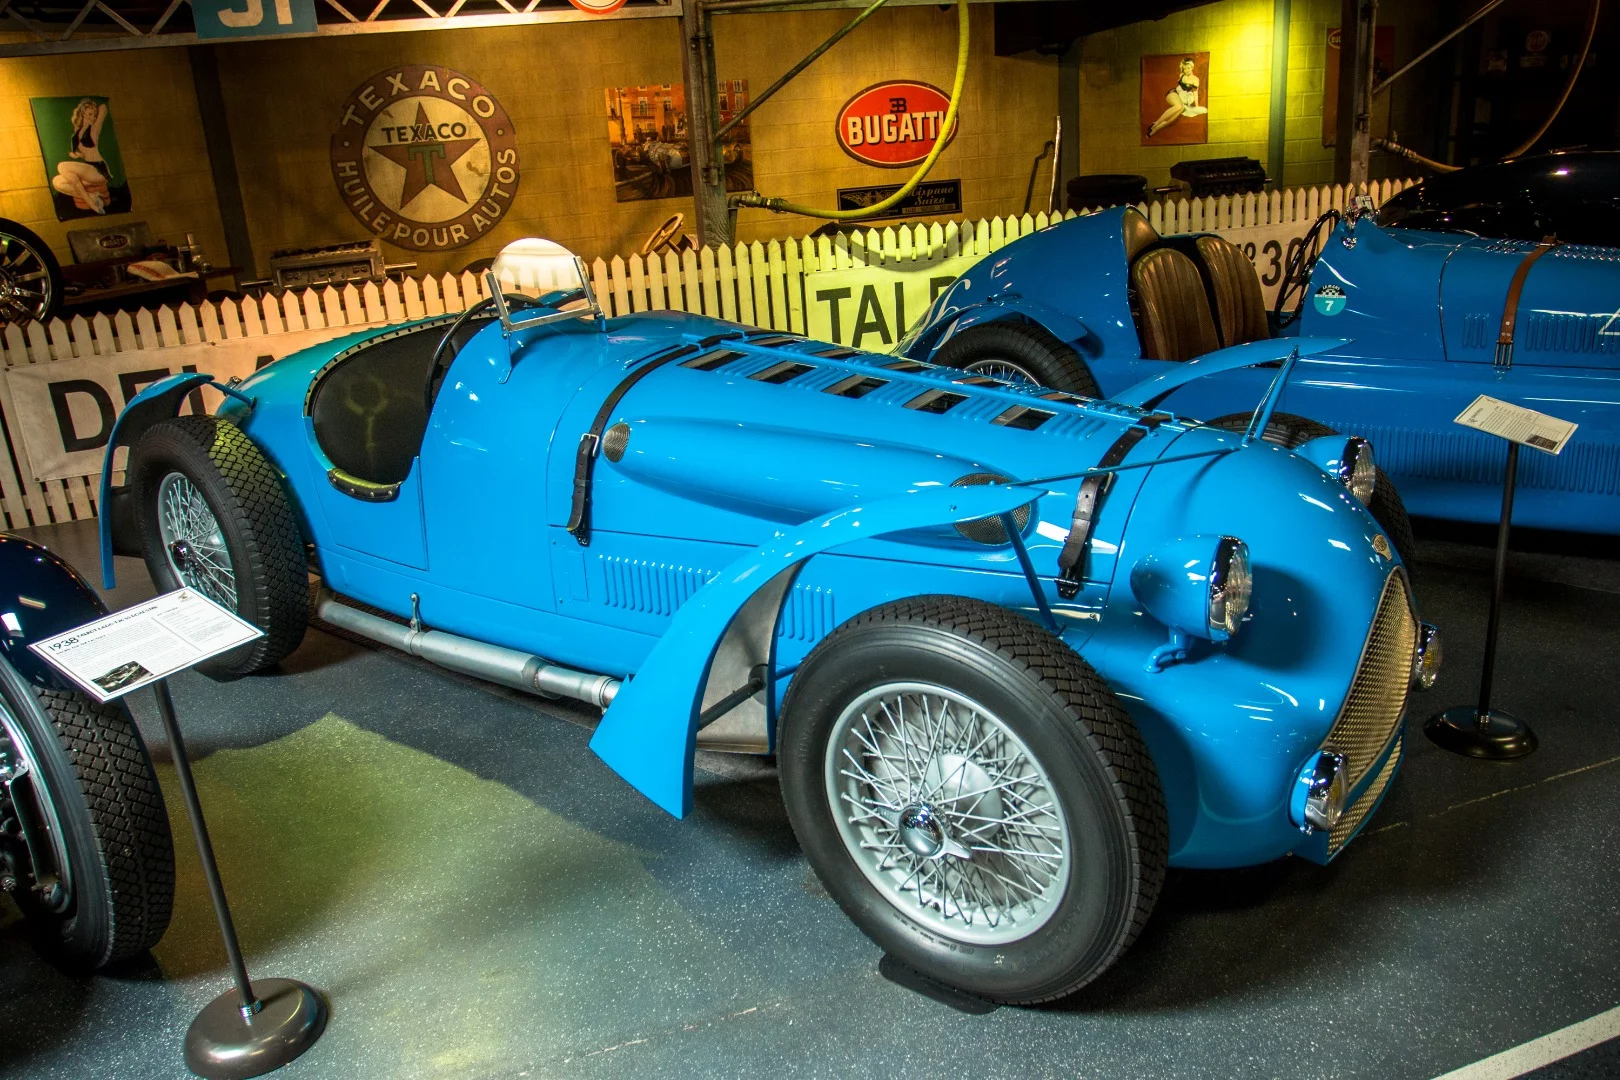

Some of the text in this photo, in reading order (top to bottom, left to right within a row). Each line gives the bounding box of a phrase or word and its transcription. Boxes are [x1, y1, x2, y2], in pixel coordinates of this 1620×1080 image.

[341, 70, 495, 126] TEXACO
[381, 122, 467, 144] TEXACO
[336, 148, 516, 247] HUILE POUR AUTOS
[1325, 300, 1334, 312] 7
[47, 636, 79, 652] 1938
